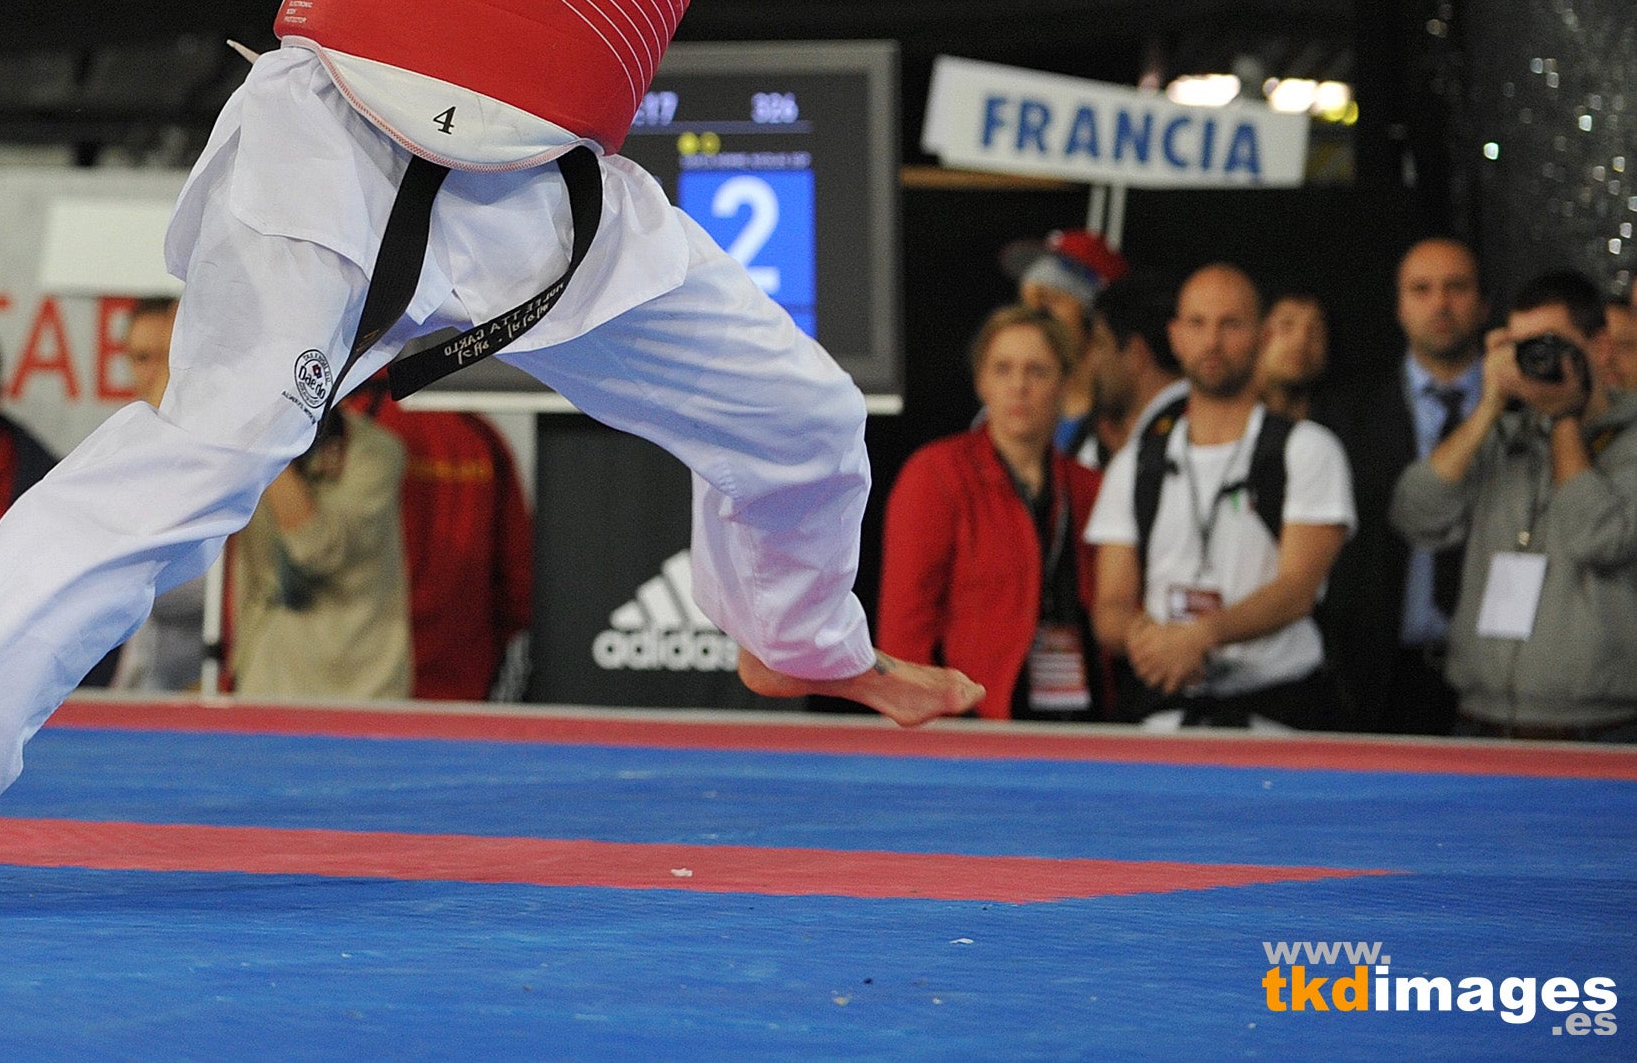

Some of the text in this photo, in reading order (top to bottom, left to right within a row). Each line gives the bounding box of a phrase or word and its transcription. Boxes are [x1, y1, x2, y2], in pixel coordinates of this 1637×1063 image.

[432, 105, 457, 135] 4
[980, 93, 1262, 177] FRANCIA
[712, 173, 782, 295] 2
